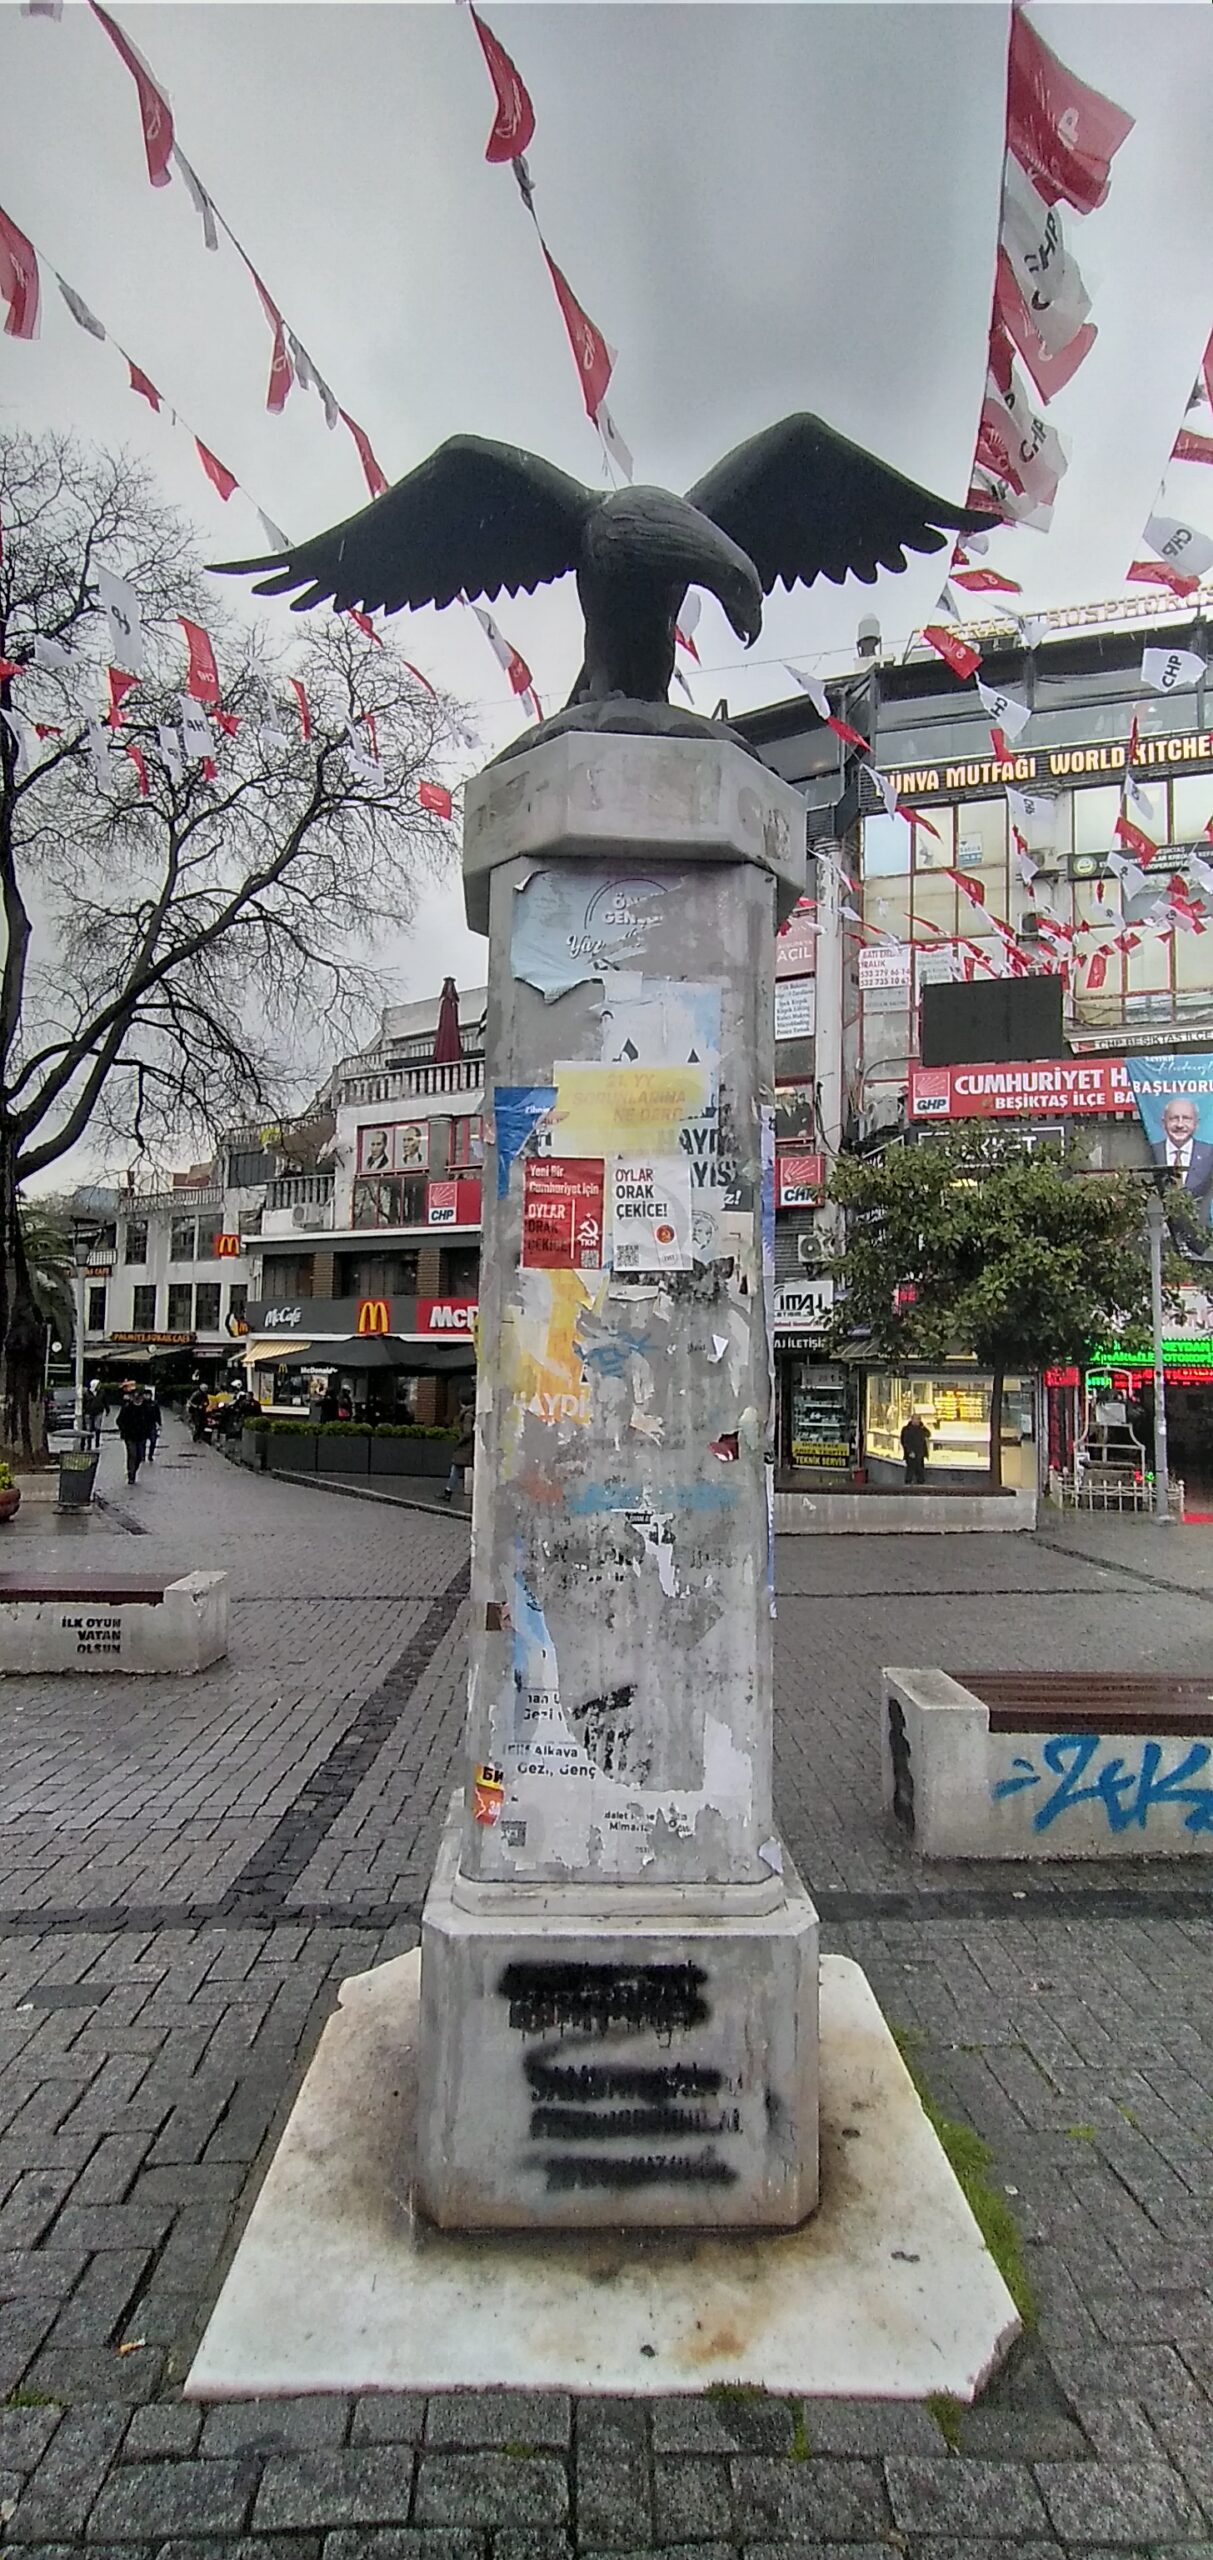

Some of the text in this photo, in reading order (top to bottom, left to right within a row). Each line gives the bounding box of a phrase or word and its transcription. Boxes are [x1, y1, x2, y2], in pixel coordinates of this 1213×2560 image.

[1161, 654, 1183, 688] CHP
[946, 757, 1036, 788] MUTFAĞI
[1050, 747, 1125, 775] WORLD
[954, 1066, 1104, 1096] CUMHURİYET
[995, 1093, 1068, 1111] BEŞİKTAŞ
[1073, 1091, 1105, 1108] İLÇE
[530, 1164, 564, 1178] Yeni Bir
[615, 1168, 654, 1182] OYLAR
[529, 1180, 581, 1197] Cumhuriyet
[616, 1184, 654, 1199] ORAK
[431, 1208, 454, 1222] CHP
[528, 1203, 566, 1219] OYLAR
[616, 1200, 668, 1221] ÇEKİCE!
[62, 1615, 121, 1629] İLK OYUN
[78, 1630, 121, 1641] VATAN
[77, 1644, 121, 1654] OLSUN
